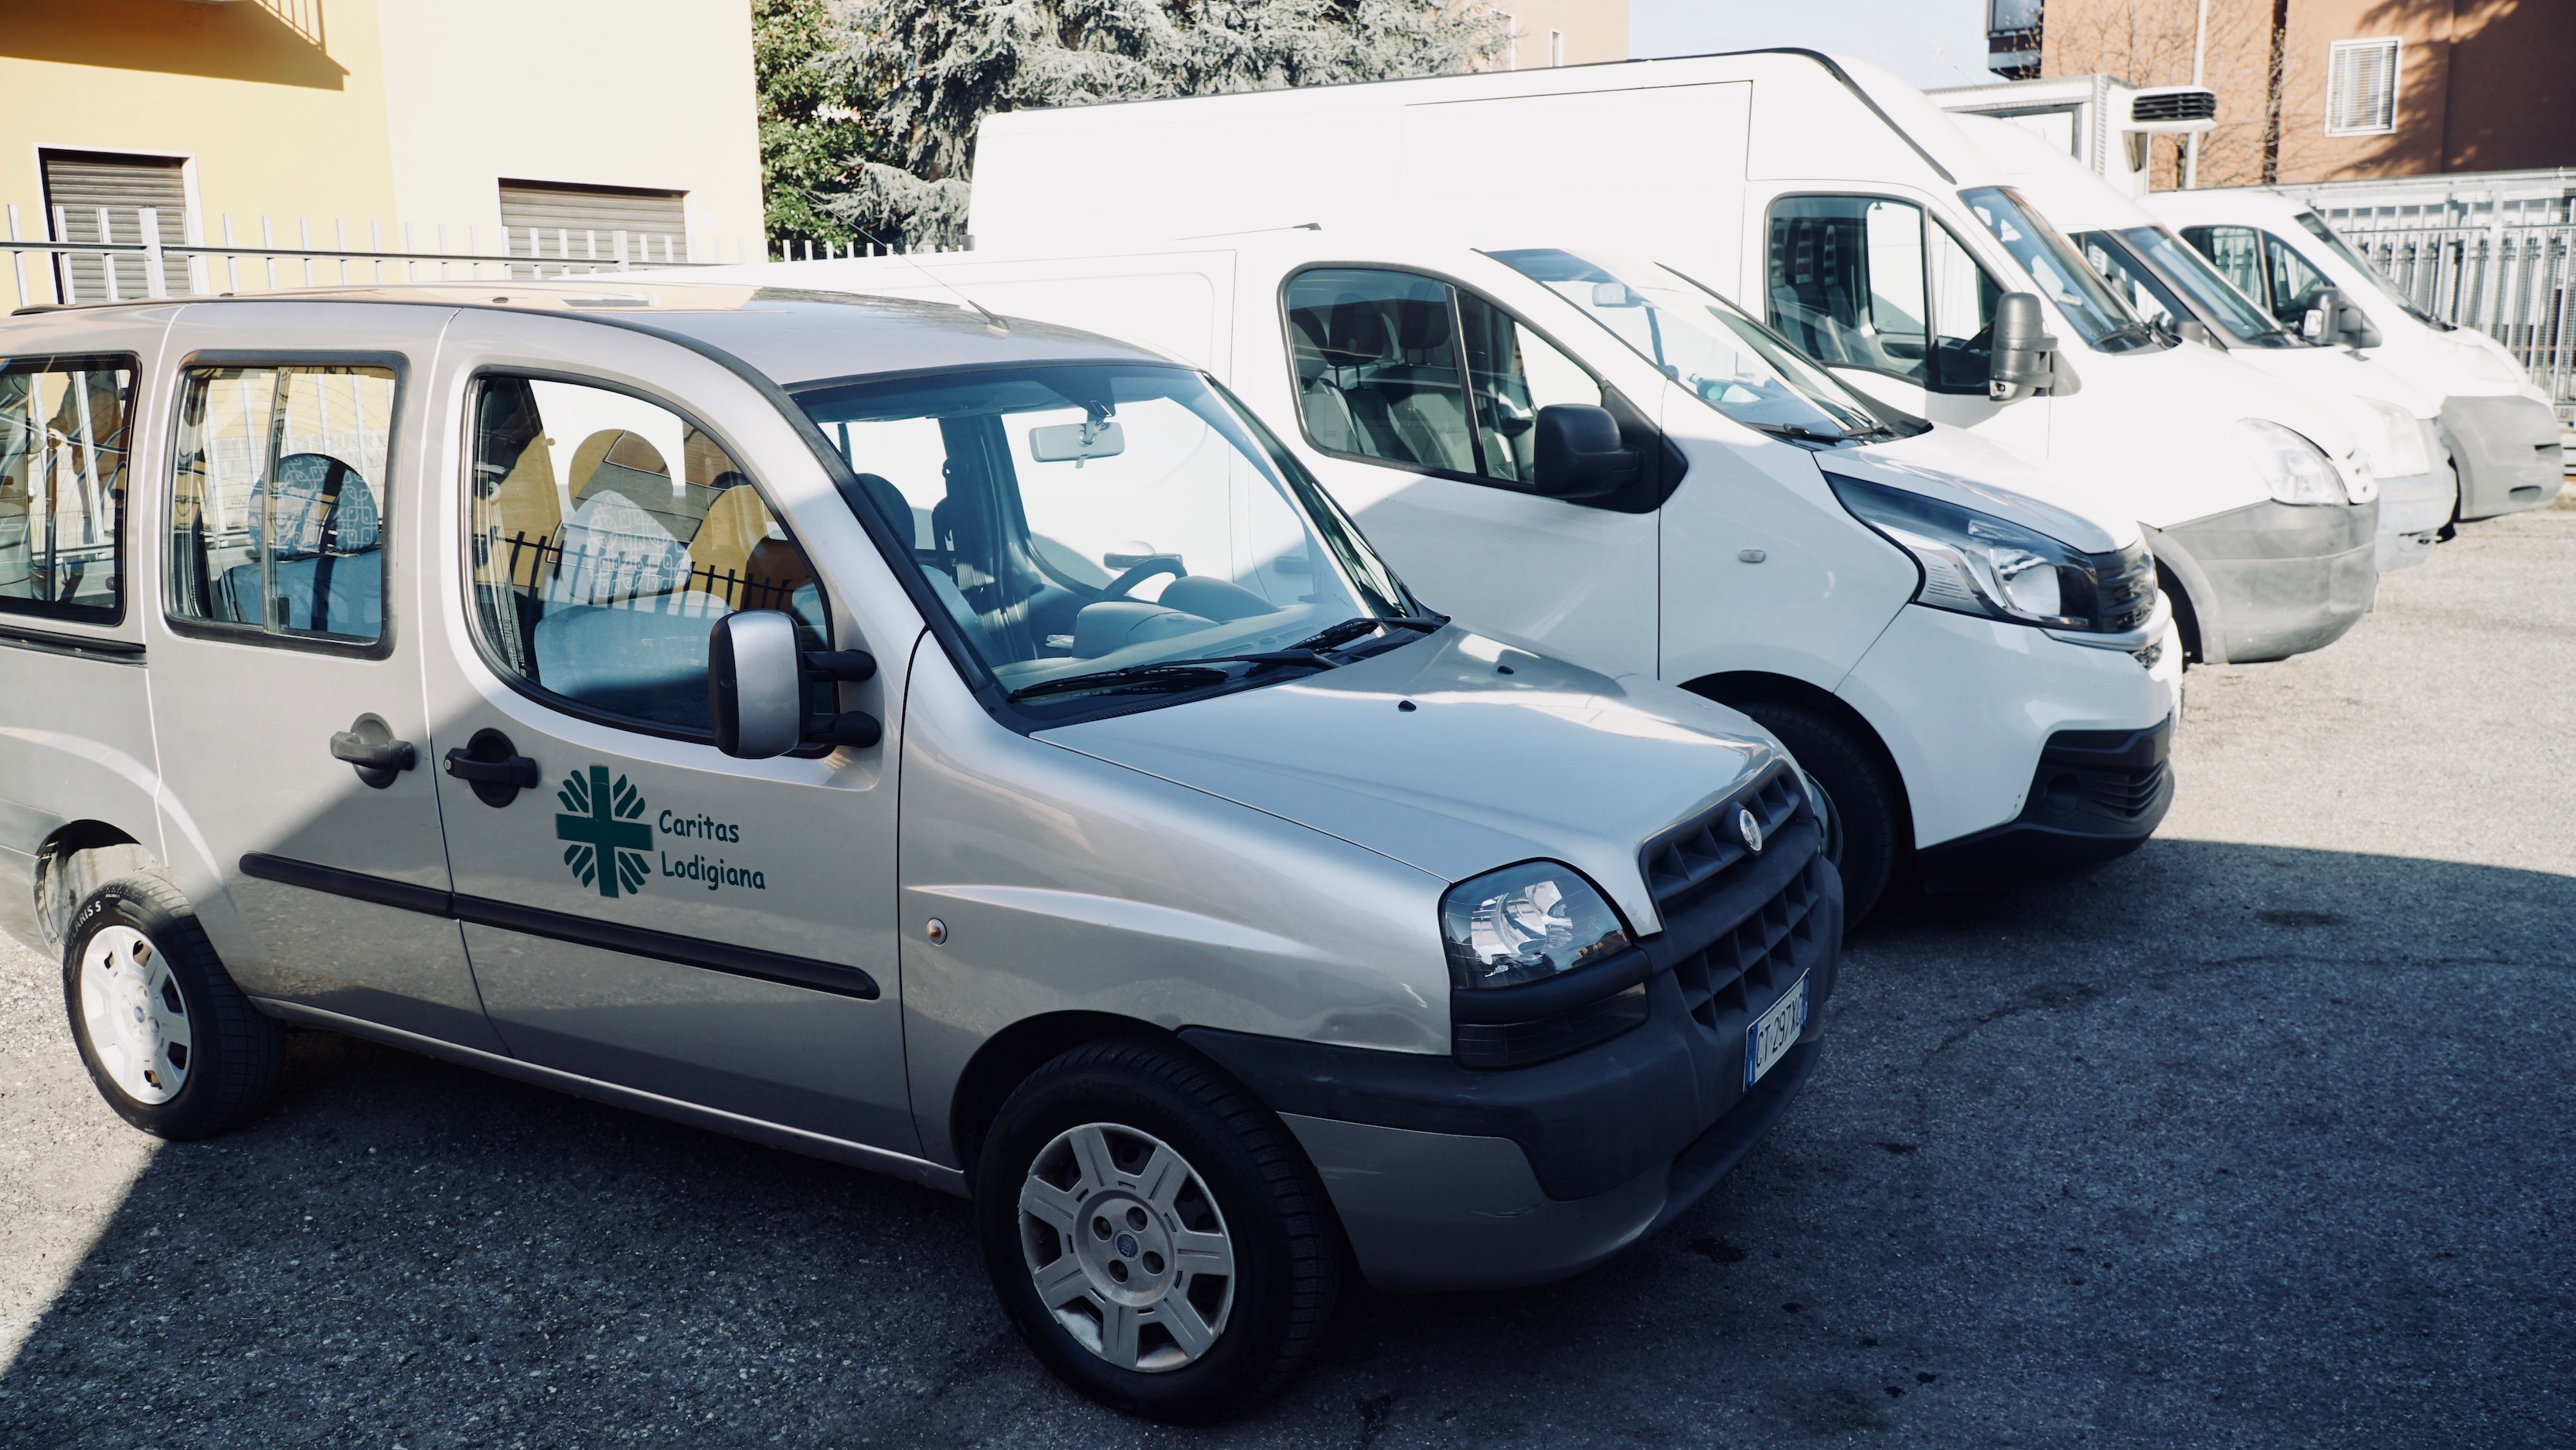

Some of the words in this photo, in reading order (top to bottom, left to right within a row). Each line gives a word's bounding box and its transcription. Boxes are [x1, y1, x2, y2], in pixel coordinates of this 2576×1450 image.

[659, 809, 740, 843] Caritas
[662, 850, 766, 891] Lodigiana
[94, 900, 102, 913] 5
[1755, 1023, 1771, 1069] CT
